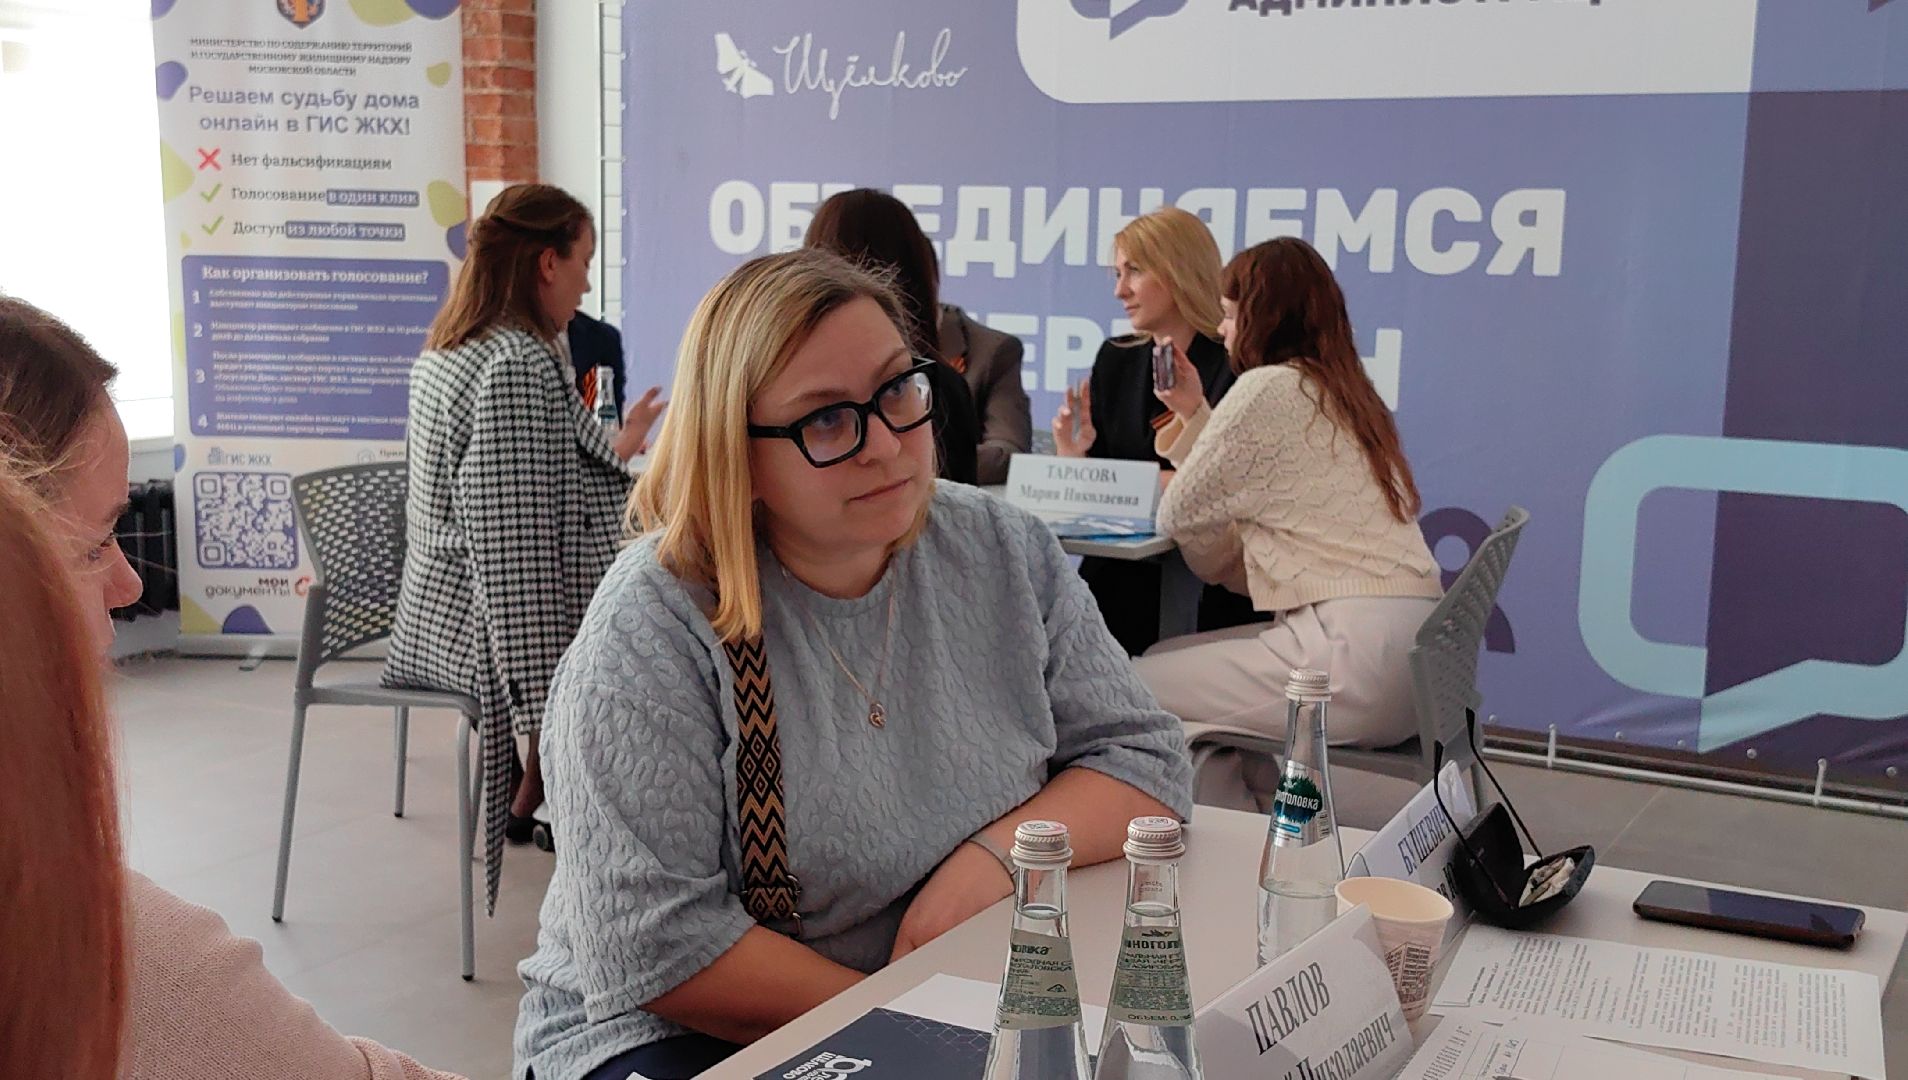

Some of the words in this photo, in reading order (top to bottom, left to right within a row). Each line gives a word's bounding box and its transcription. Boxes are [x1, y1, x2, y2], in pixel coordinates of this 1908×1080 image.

[189, 86, 274, 105] Решаем
[281, 90, 357, 110] судьбу
[364, 94, 419, 110] дома
[200, 112, 278, 132] онлайн
[287, 118, 299, 132] в
[306, 115, 348, 134] ГИС
[355, 116, 410, 136] ЖКХ!
[231, 153, 258, 167] Нет
[262, 153, 392, 171] фальсификациям
[232, 187, 326, 202] Голосование
[233, 222, 285, 237] Доступ
[288, 225, 306, 237] из
[308, 222, 357, 239] любой
[359, 225, 404, 239] точки
[709, 180, 1567, 279] ОБЕДИНЯЕМСЯ
[202, 265, 231, 279] Как
[233, 268, 331, 284] организовать
[332, 270, 429, 285] голосование?
[194, 322, 203, 337] 2
[198, 414, 208, 429] 4
[226, 453, 245, 465] ГИС
[248, 453, 272, 466] ЖКХ
[1245, 961, 1330, 1056] ПАВЛОВ
